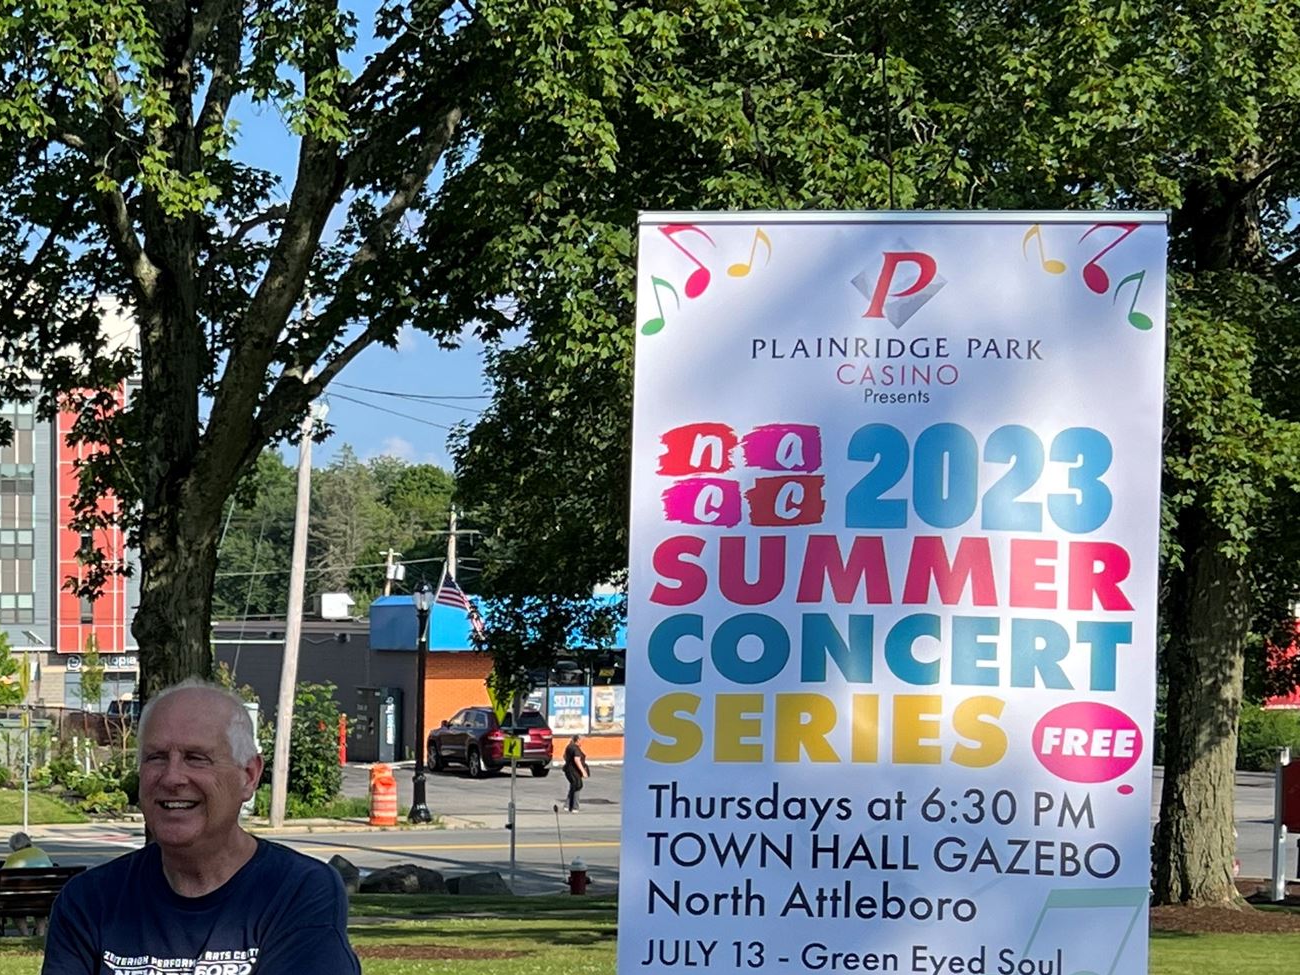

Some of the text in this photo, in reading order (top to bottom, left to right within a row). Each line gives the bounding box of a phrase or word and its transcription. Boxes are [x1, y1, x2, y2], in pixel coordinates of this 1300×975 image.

[752, 338, 1044, 360] PLAINRIDGE PARK
[837, 364, 959, 386] CASINO
[864, 388, 930, 404] Presents
[845, 422, 1114, 534] 2023
[649, 535, 1135, 612] SUMMER
[647, 612, 1133, 692] CONCERT
[644, 692, 1009, 768] SERIES
[1040, 727, 1137, 759] FREE
[648, 782, 1096, 831] Thursdays at 6:30 PM
[647, 832, 1121, 879] TOWN HALL GAZEBO
[647, 879, 977, 922] North Attleboro
[151, 953, 202, 968] PERFORM
[641, 940, 718, 968] JULY
[732, 941, 766, 968] 13
[801, 943, 899, 972] Green
